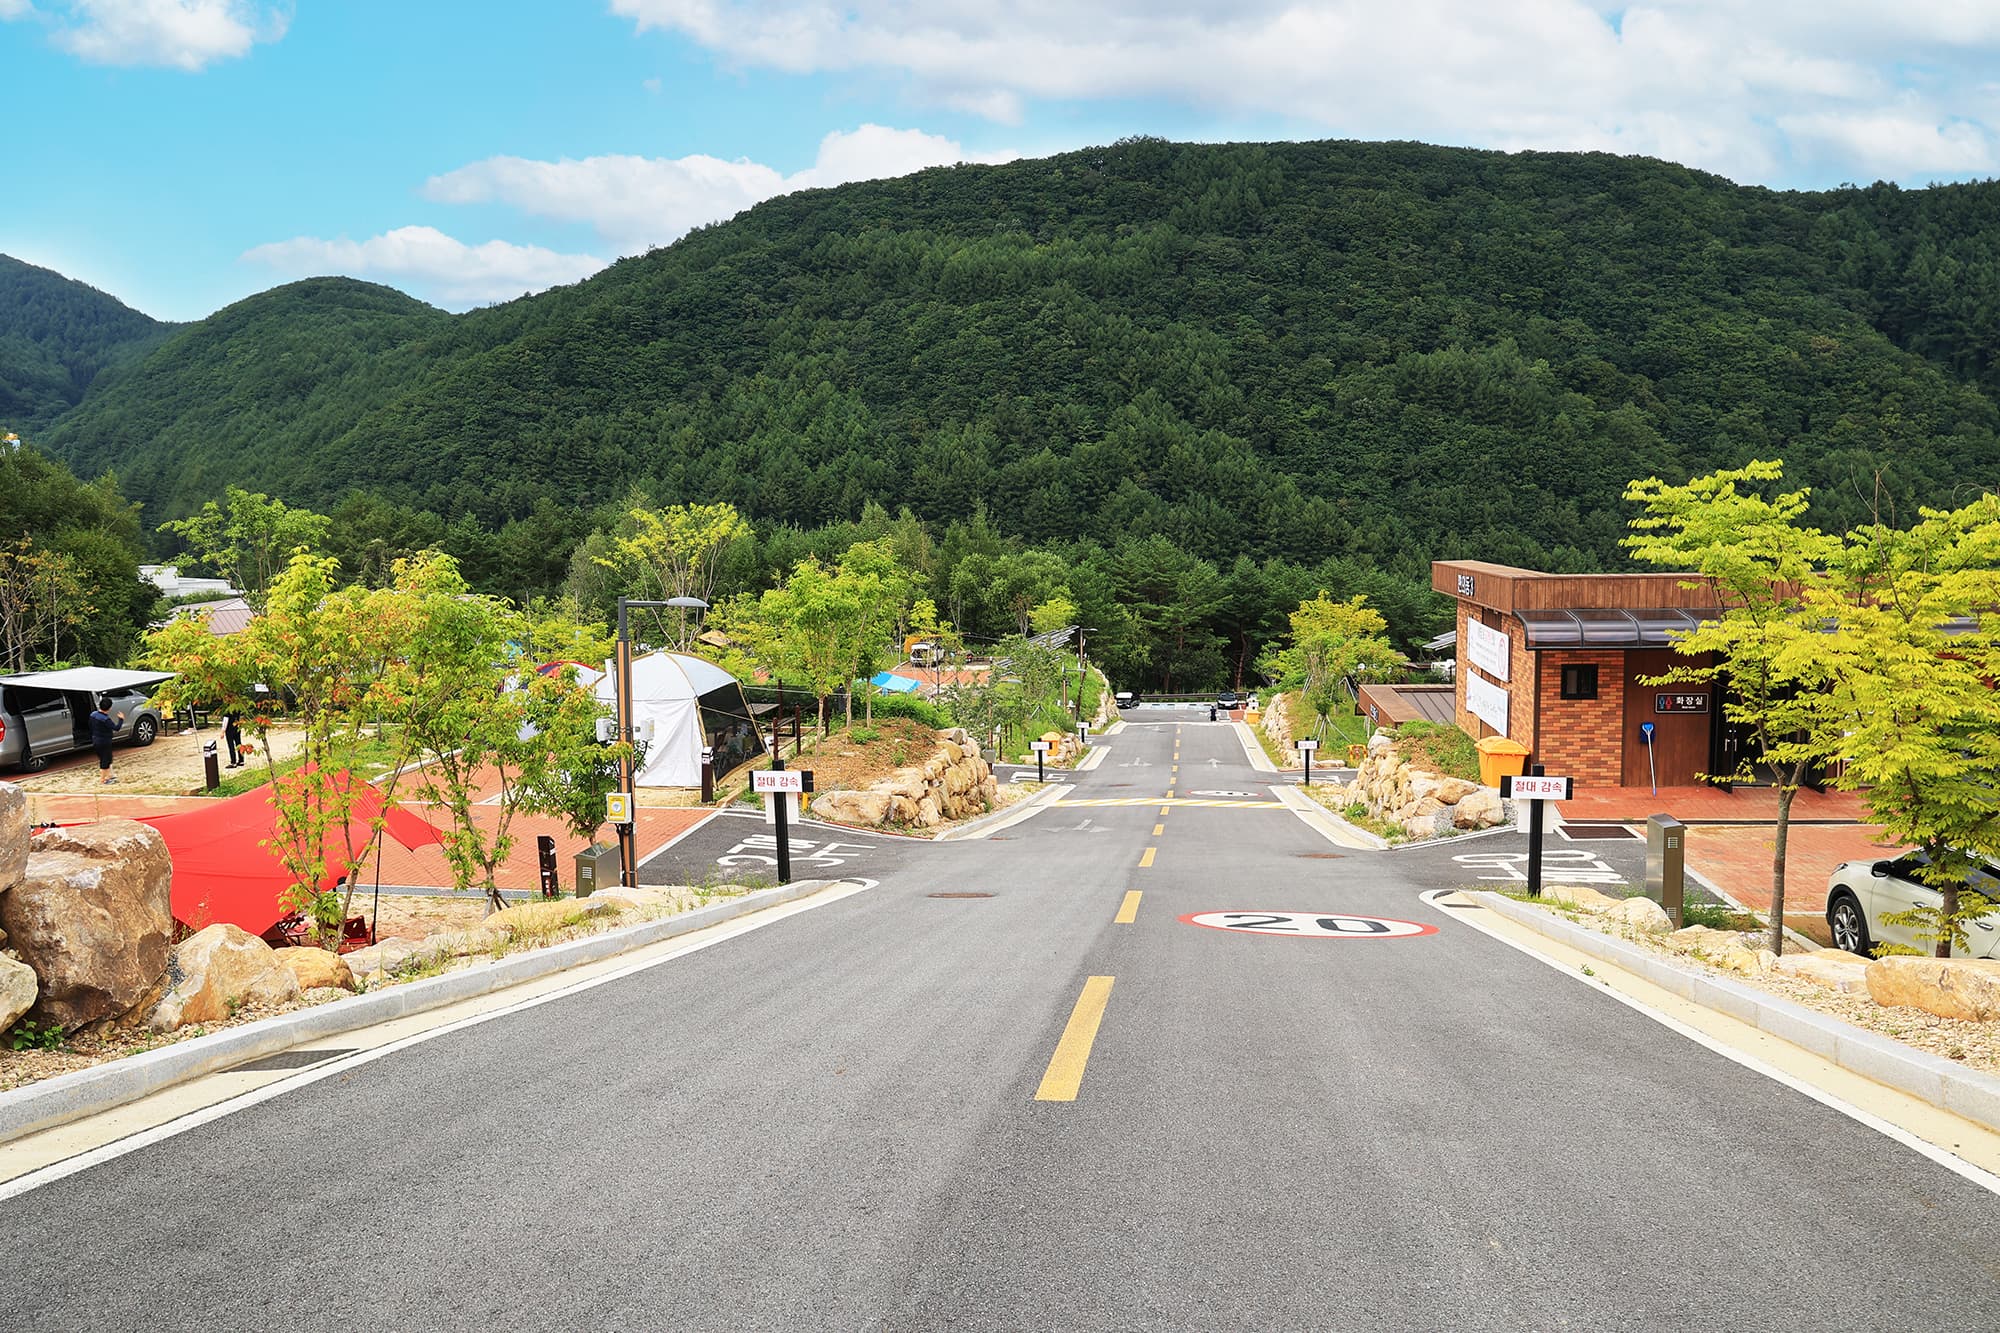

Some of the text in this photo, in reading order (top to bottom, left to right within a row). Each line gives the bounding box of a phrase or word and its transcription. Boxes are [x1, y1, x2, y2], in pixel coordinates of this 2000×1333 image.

[1676, 696, 1703, 705] 화장실
[757, 776, 799, 787] 절대 감속
[1515, 781, 1562, 793] 절대 감속
[1224, 914, 1392, 934] 20
